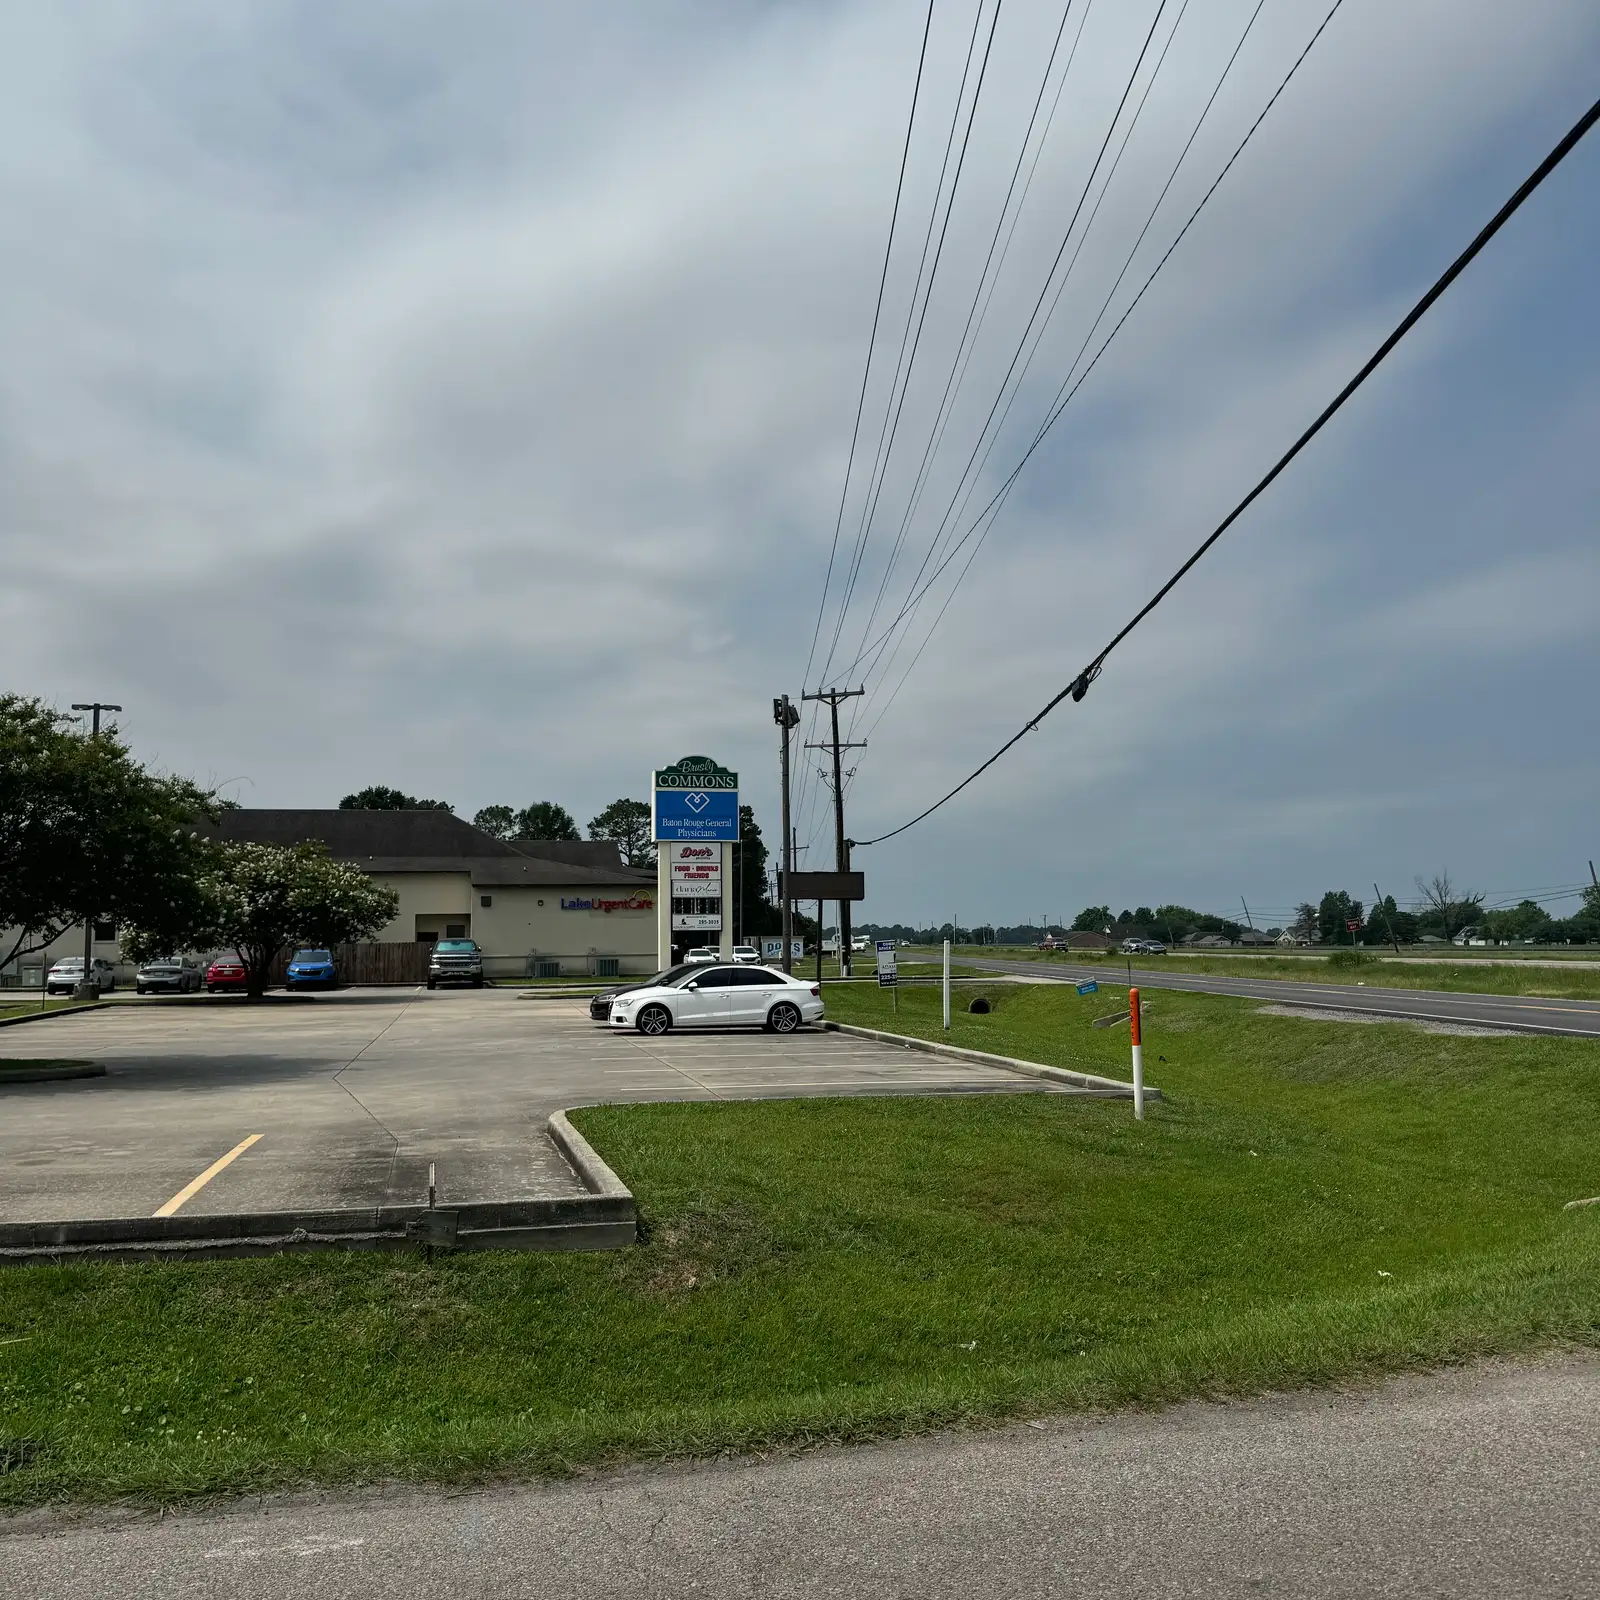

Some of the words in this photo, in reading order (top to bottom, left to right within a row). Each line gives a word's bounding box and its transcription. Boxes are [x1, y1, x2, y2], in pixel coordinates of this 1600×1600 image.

[678, 760, 715, 774] Brusly
[659, 775, 735, 788] COMMONS
[662, 818, 683, 827] Baton
[683, 818, 705, 828] Rouge
[705, 818, 732, 827] General
[677, 828, 717, 838] Physicians
[680, 847, 714, 858] Don's
